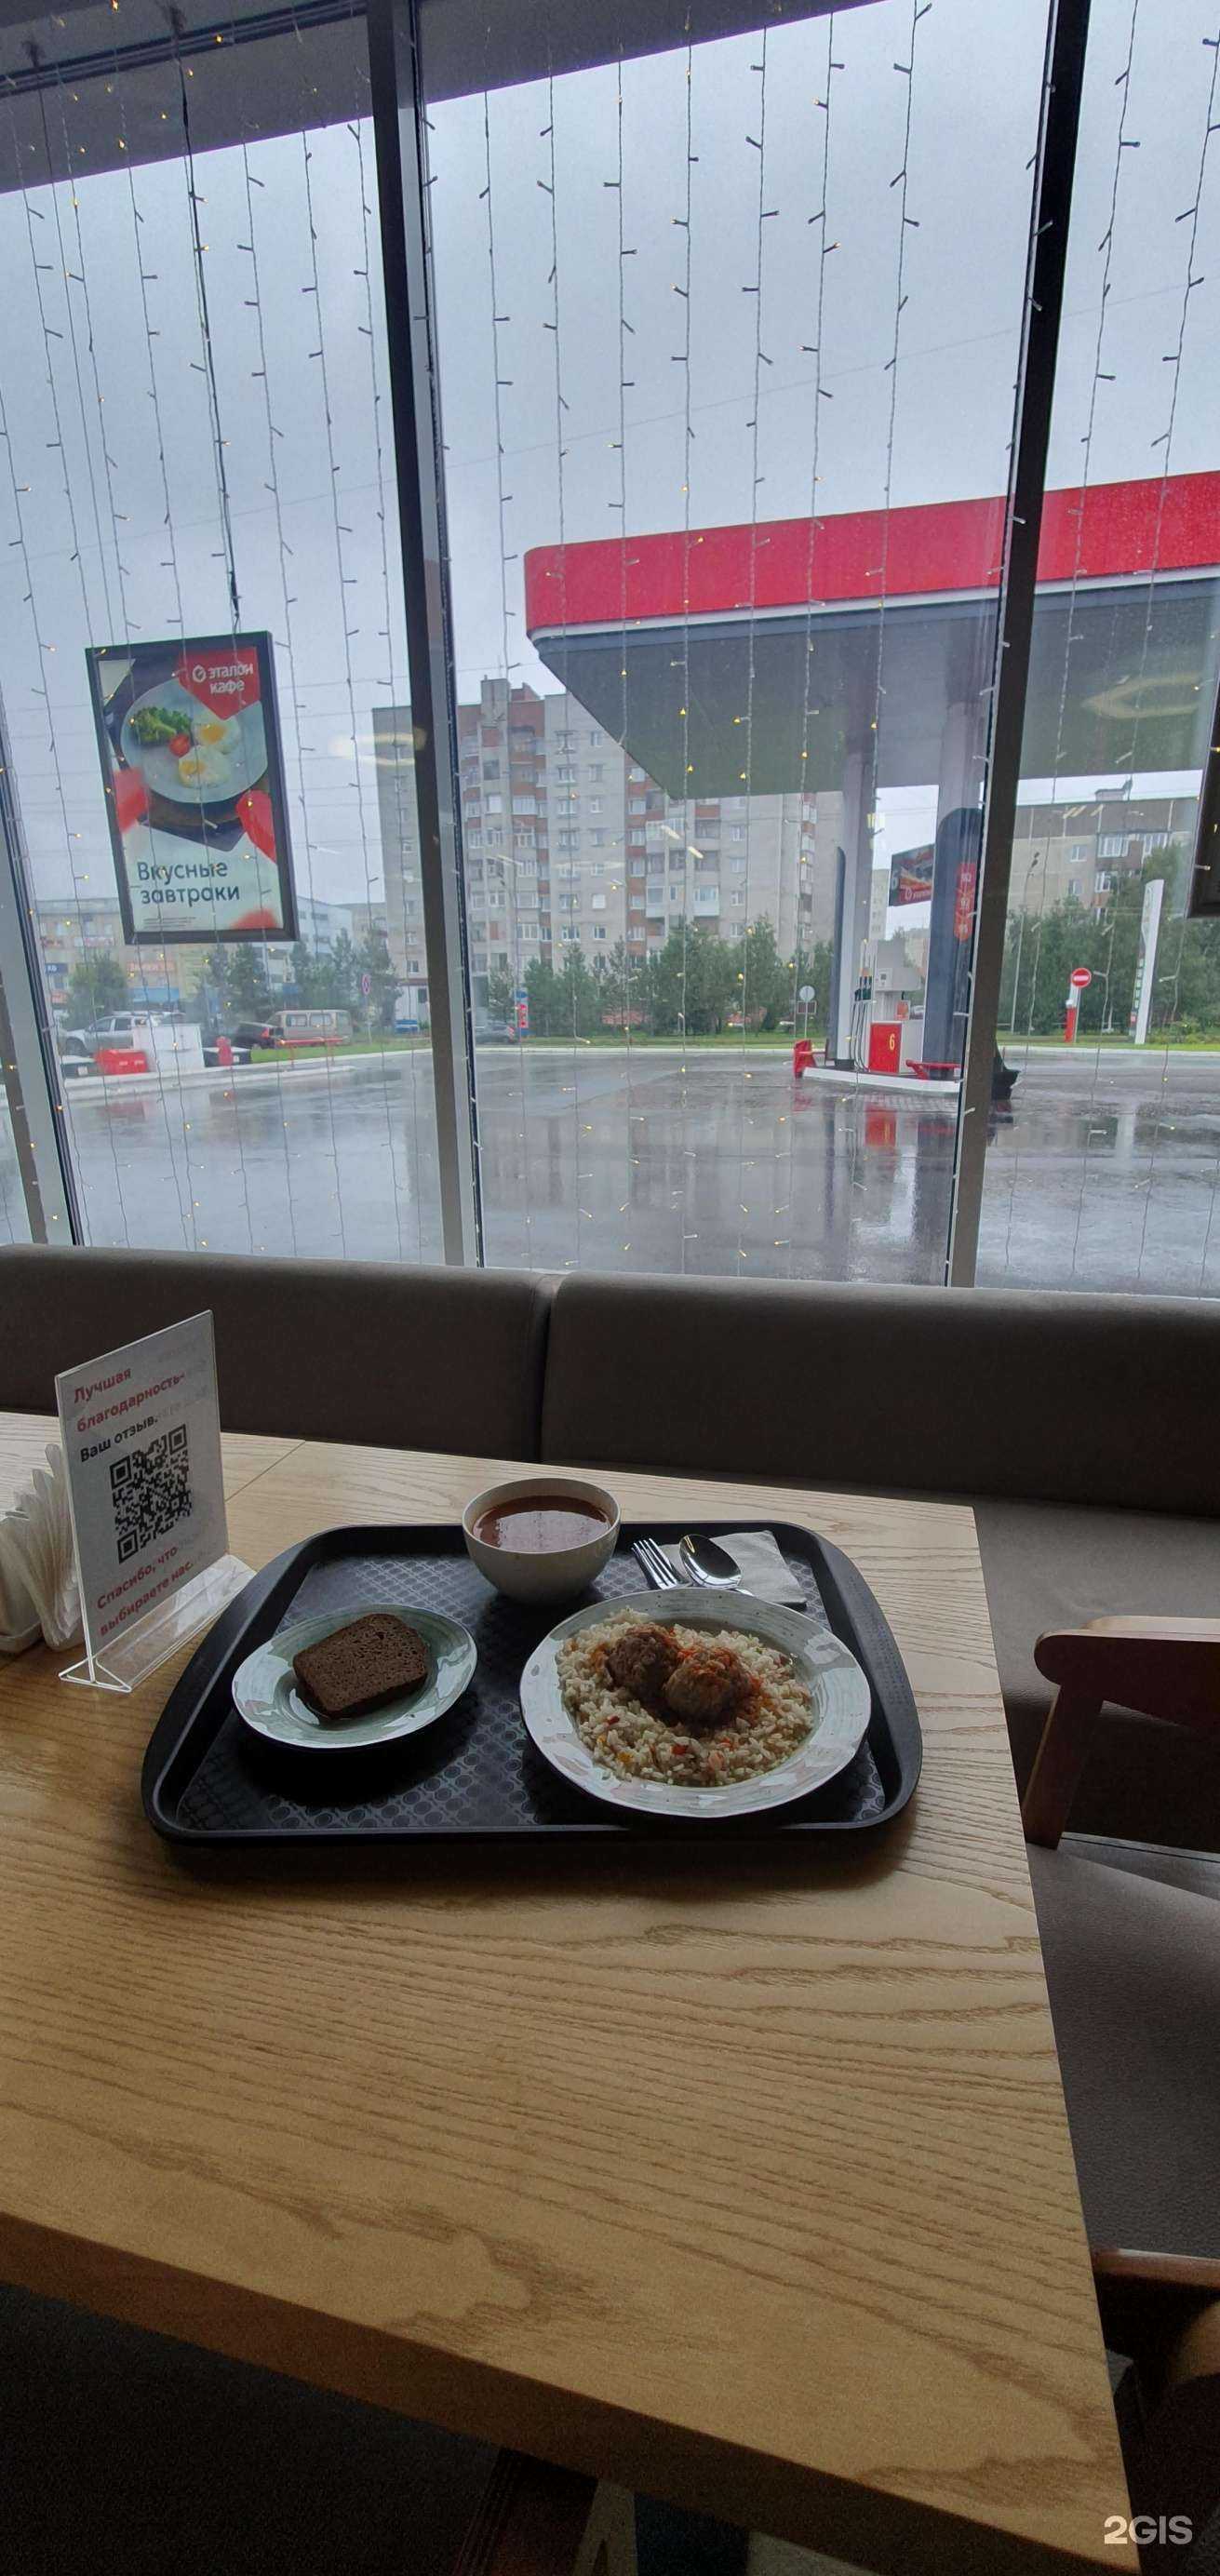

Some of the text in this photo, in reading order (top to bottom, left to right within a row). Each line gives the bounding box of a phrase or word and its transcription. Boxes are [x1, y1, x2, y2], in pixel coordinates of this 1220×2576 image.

[209, 679, 245, 694] кафе
[137, 861, 228, 885] Вкусные
[141, 885, 240, 907] завтраки
[889, 1032, 895, 1051] 6
[74, 1368, 131, 1403] Лучшая
[80, 1415, 158, 1462] Ваш отзыв.
[97, 1547, 178, 1609] Спасибо, что
[100, 1578, 169, 1636] выбираете
